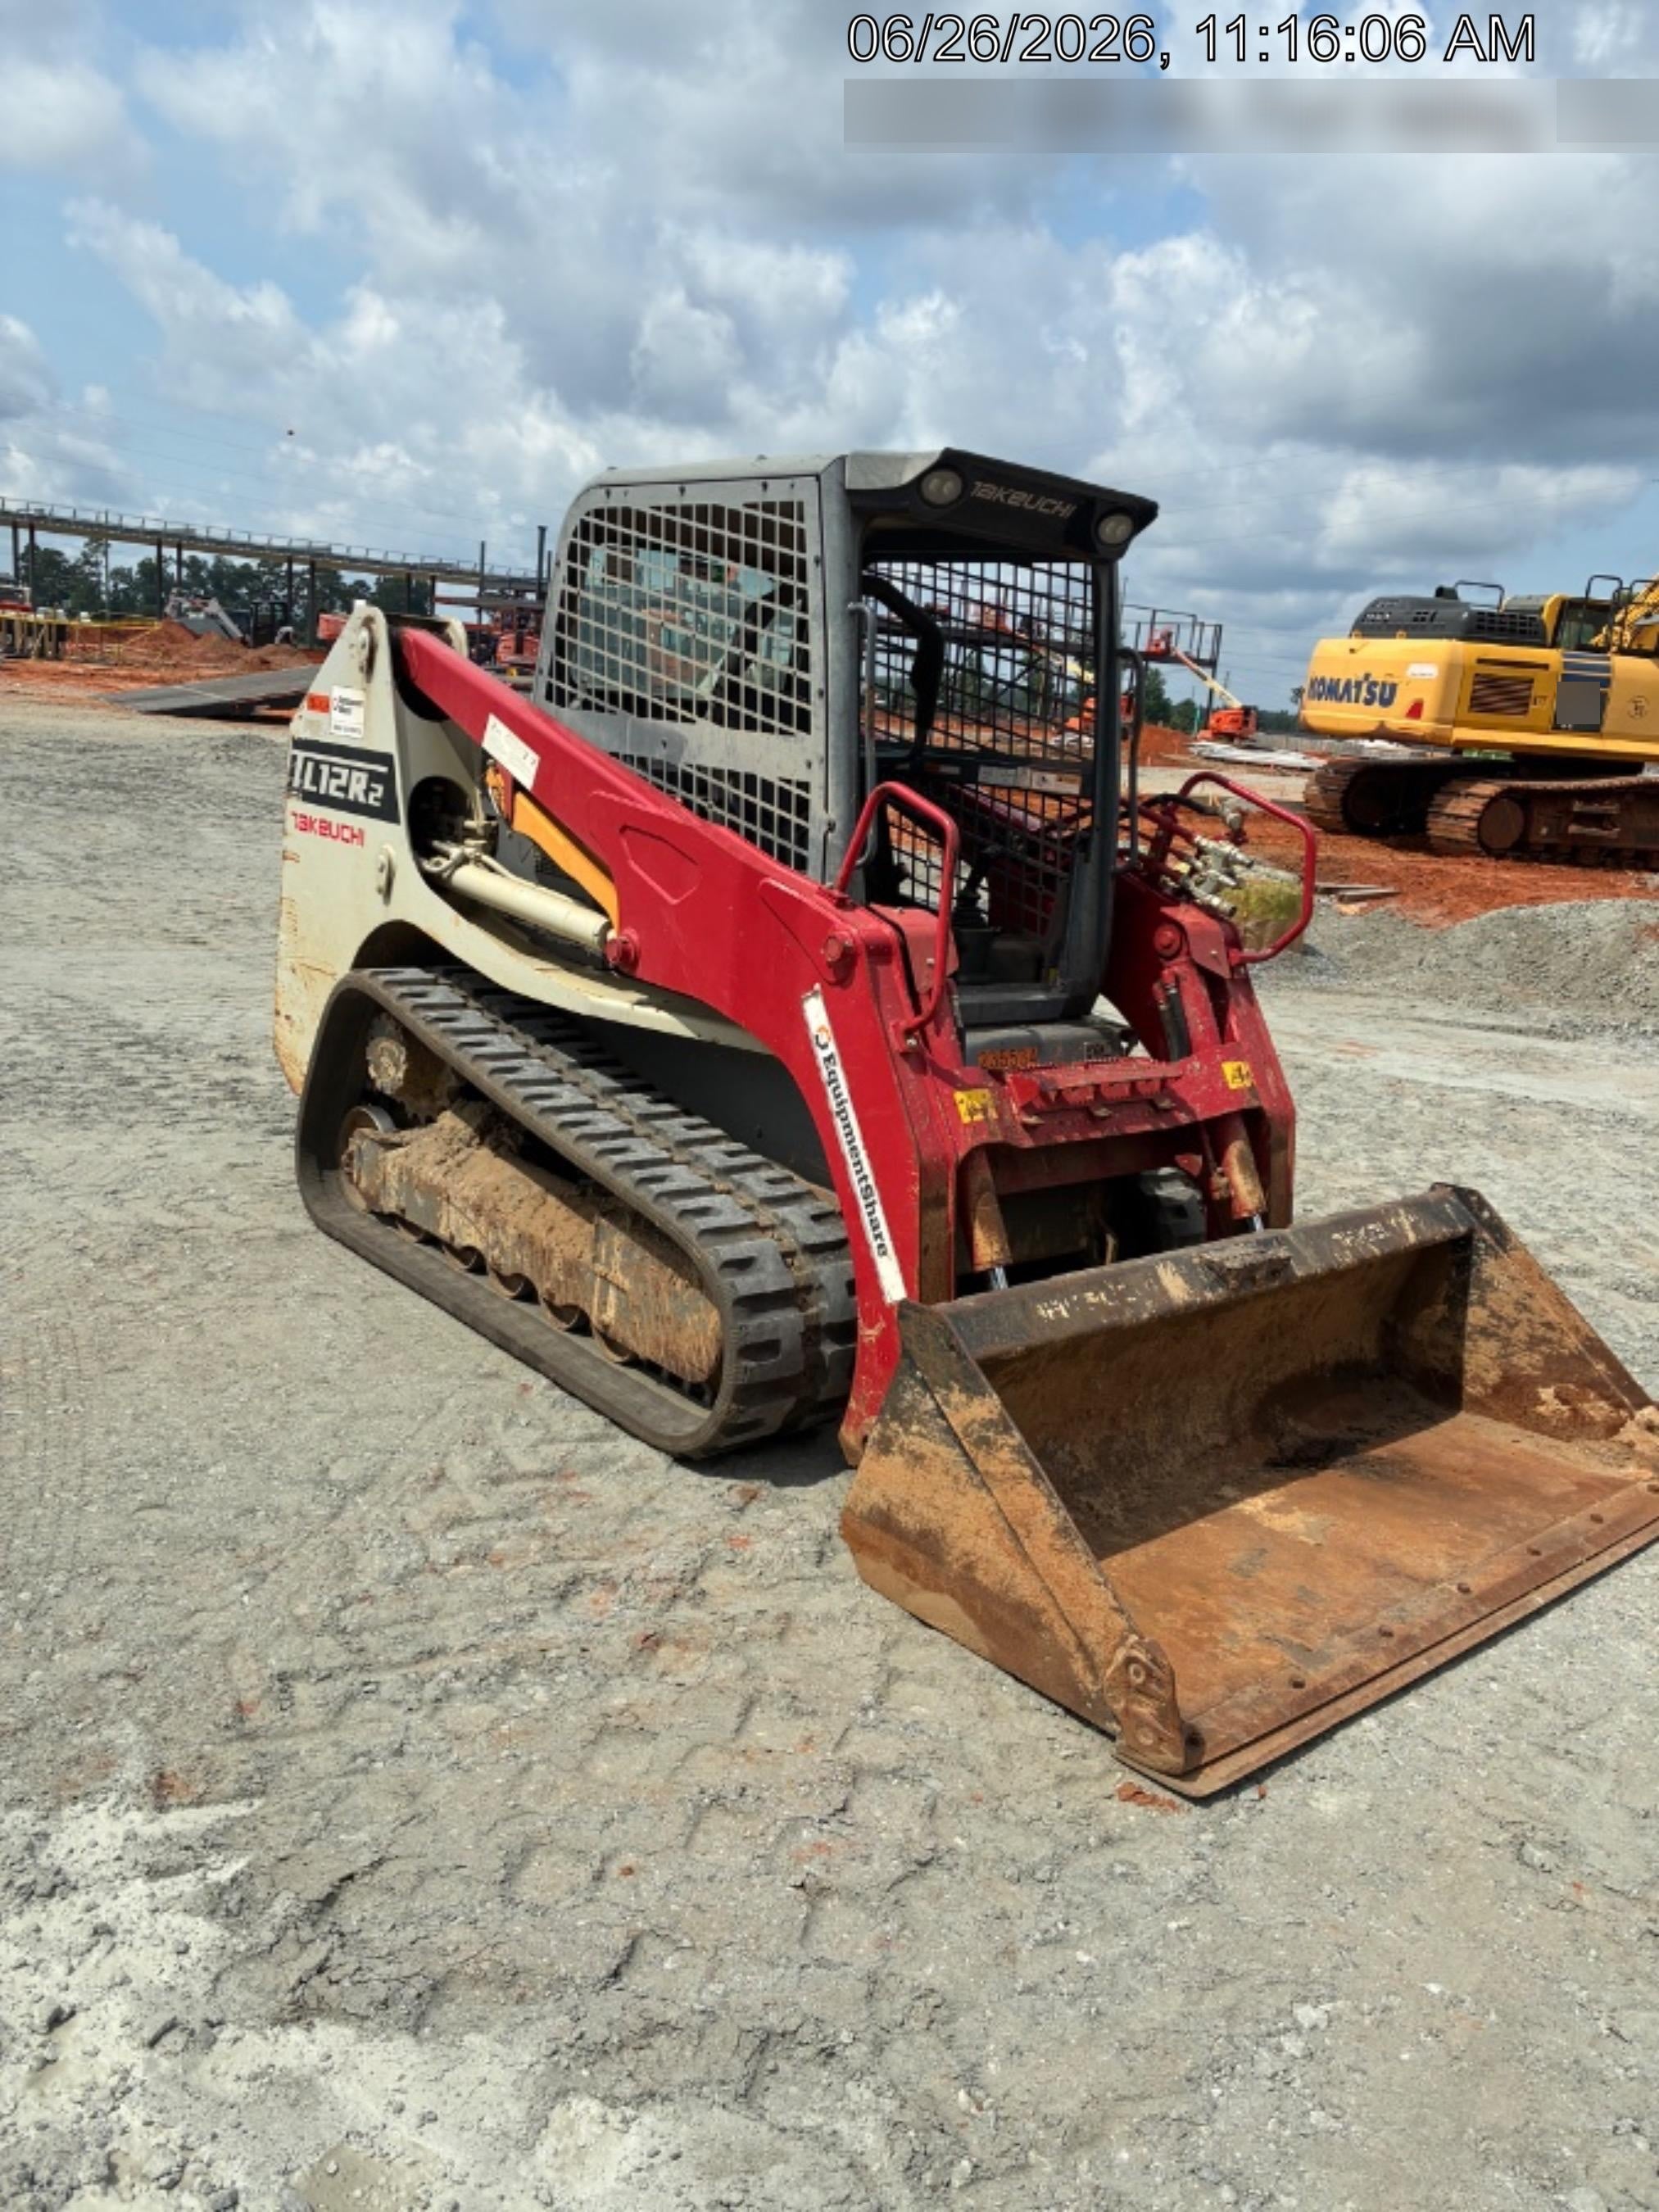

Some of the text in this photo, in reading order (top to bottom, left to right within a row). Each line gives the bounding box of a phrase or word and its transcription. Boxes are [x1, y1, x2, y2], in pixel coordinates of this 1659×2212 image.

[970, 480, 1077, 519] TAKEUCHI
[1308, 673, 1398, 709] KOMATSU
[291, 749, 389, 808] TL12R2
[291, 810, 365, 847] TAKEUCHI
[822, 1052, 889, 1258] EquipmentShare
